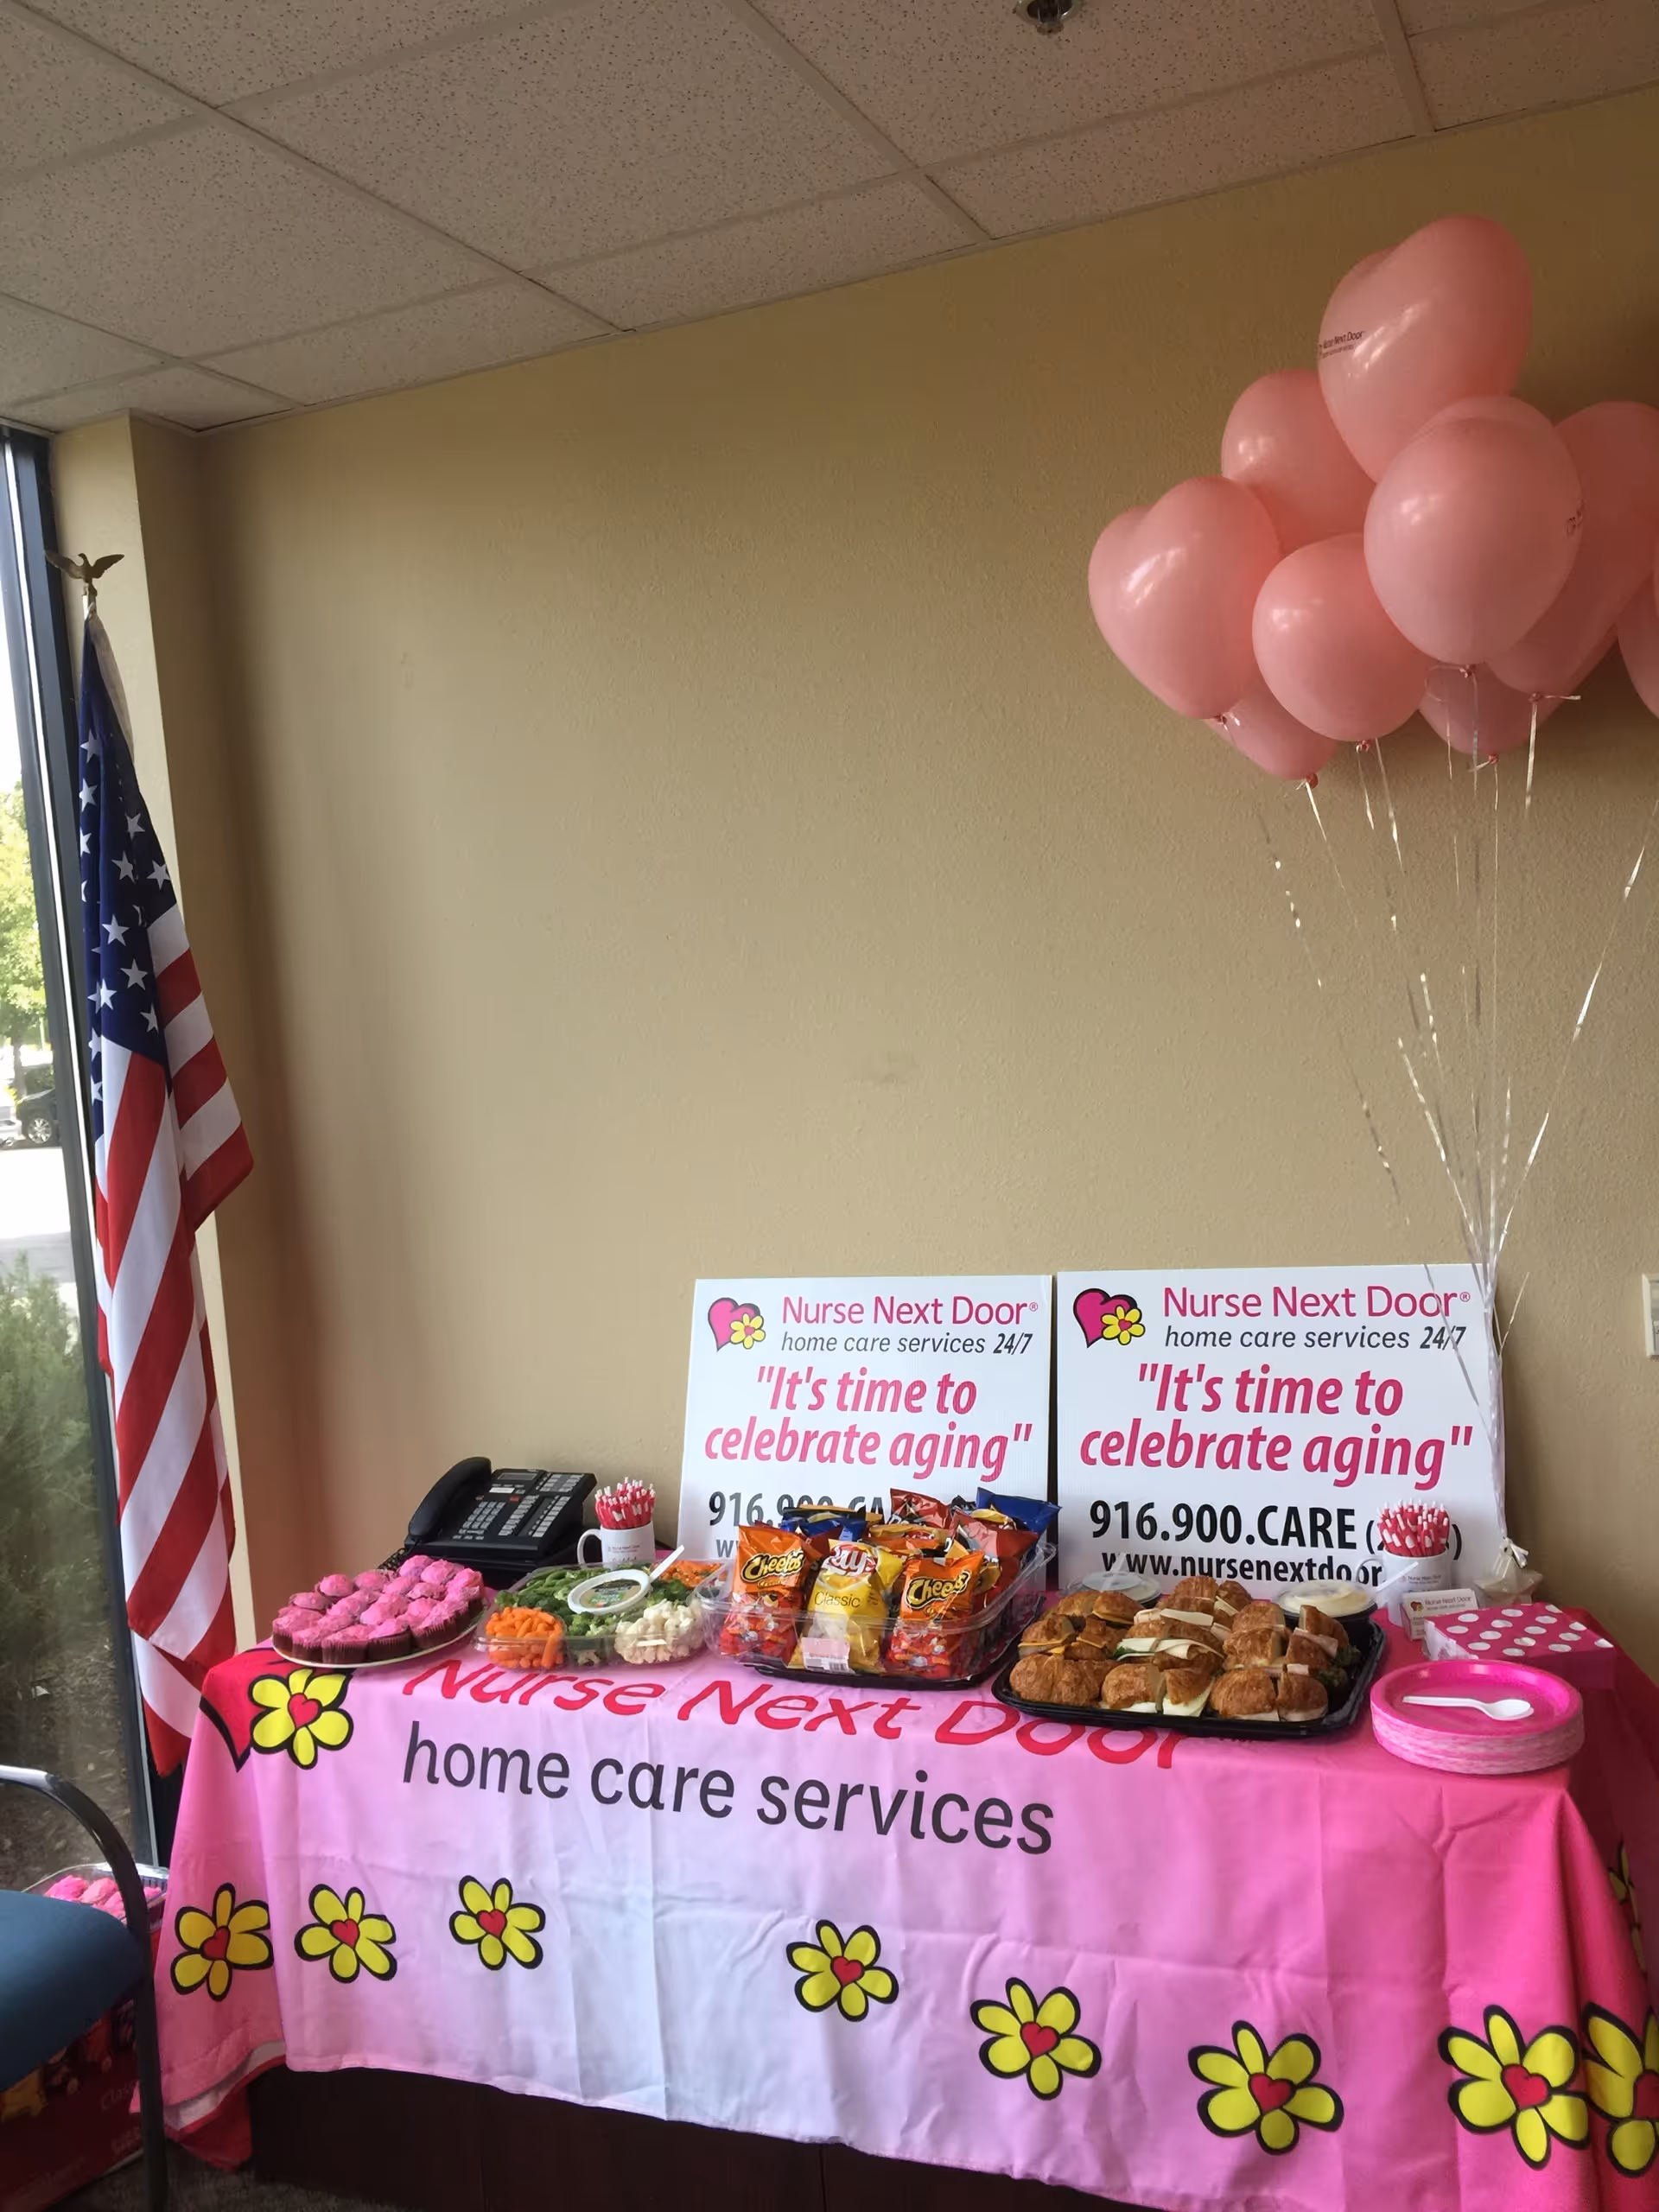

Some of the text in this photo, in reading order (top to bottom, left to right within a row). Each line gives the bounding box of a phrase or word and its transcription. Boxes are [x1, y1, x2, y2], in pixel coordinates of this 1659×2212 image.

[783, 1297, 863, 1324] Nurse
[874, 1297, 942, 1324] Next
[1164, 1287, 1262, 1317] Nurse
[1273, 1287, 1356, 1317] Next
[781, 1332, 1033, 1355] home care services 24/7
[1165, 1325, 1466, 1351] home care services 24/7
[757, 1367, 977, 1414] "It's time to
[1139, 1363, 1403, 1416] "It's time to
[705, 1417, 1033, 1483] celebrate aging"
[1080, 1418, 1472, 1491] celebrate aging"
[1090, 1500, 1357, 1549] 916.900.CARE
[744, 1549, 804, 1582] Cheetos
[814, 1592, 861, 1608] Classic
[403, 1659, 1187, 1770] Nurse Next Door
[403, 1721, 1054, 1854] home care services
